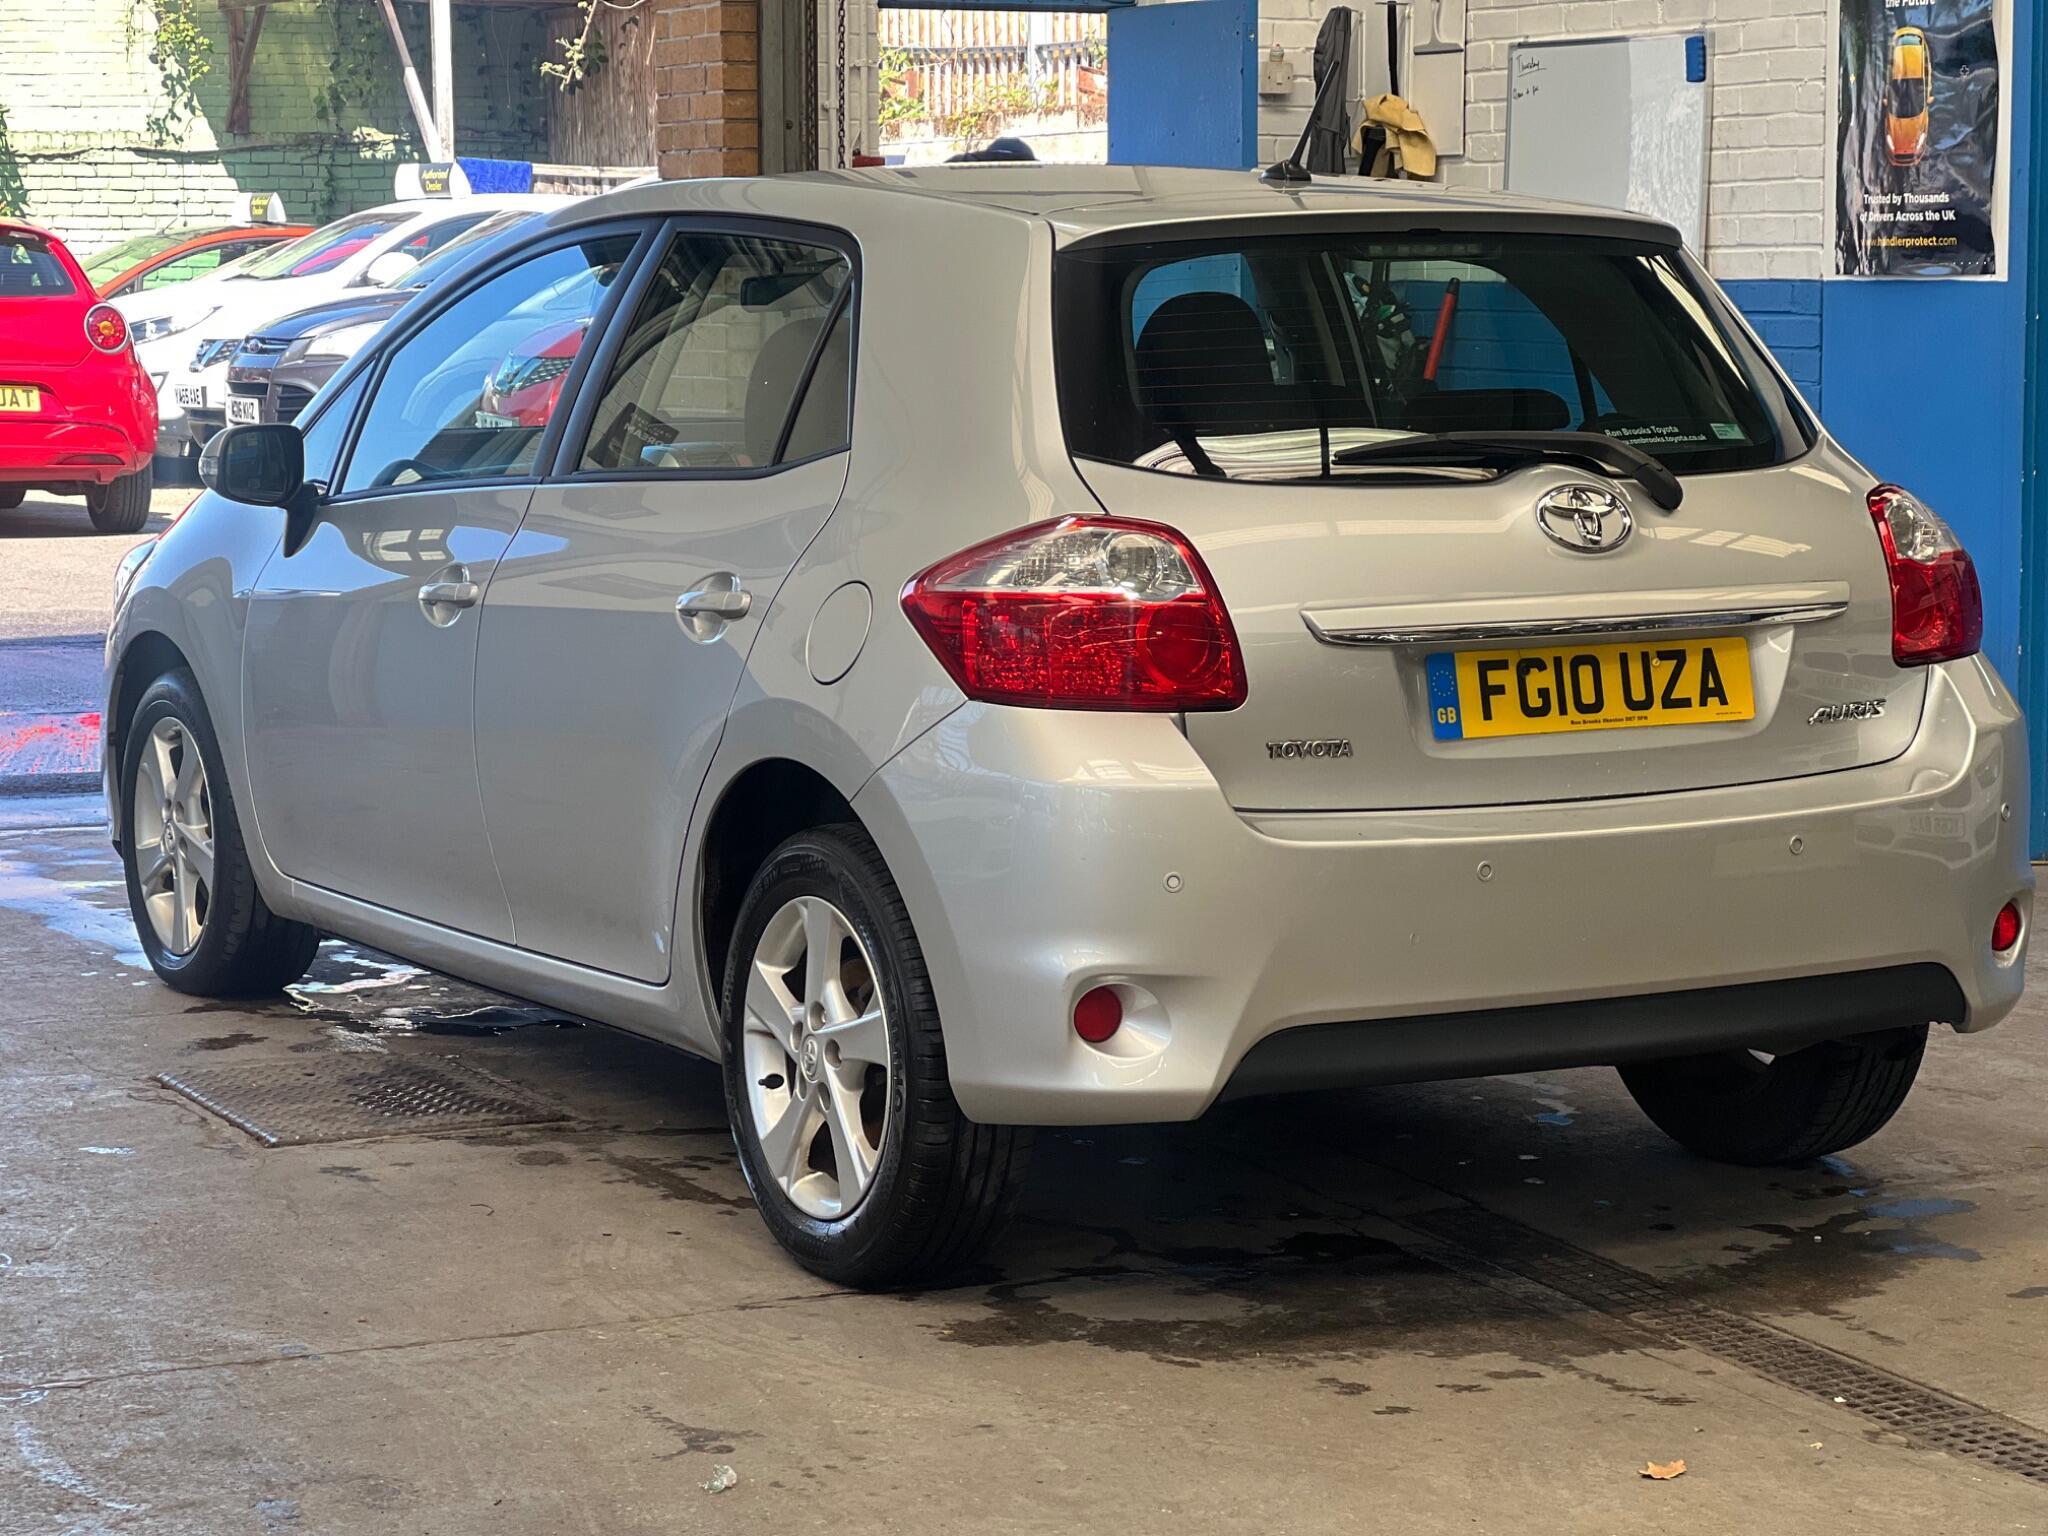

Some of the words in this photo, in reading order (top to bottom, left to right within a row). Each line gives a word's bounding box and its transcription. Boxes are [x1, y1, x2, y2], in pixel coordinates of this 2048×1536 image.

[1863, 193, 1891, 205] Trusted
[1892, 193, 1902, 206] by
[1904, 191, 1950, 204] Thousands
[1859, 211, 1868, 222] of
[1868, 211, 1894, 222] Drivers
[1895, 211, 1924, 222] Across
[1925, 210, 1941, 221] the
[1941, 209, 1956, 220] UK
[1604, 428, 1622, 438] Ron
[1622, 426, 1650, 436] Brooks
[1651, 425, 1680, 436] Toyota
[1477, 655, 1606, 721] FG10
[1619, 647, 1729, 712] UZA
[1436, 707, 1457, 724] GB
[1808, 699, 1887, 725] AURIS
[1266, 739, 1353, 760] TOYOTA
